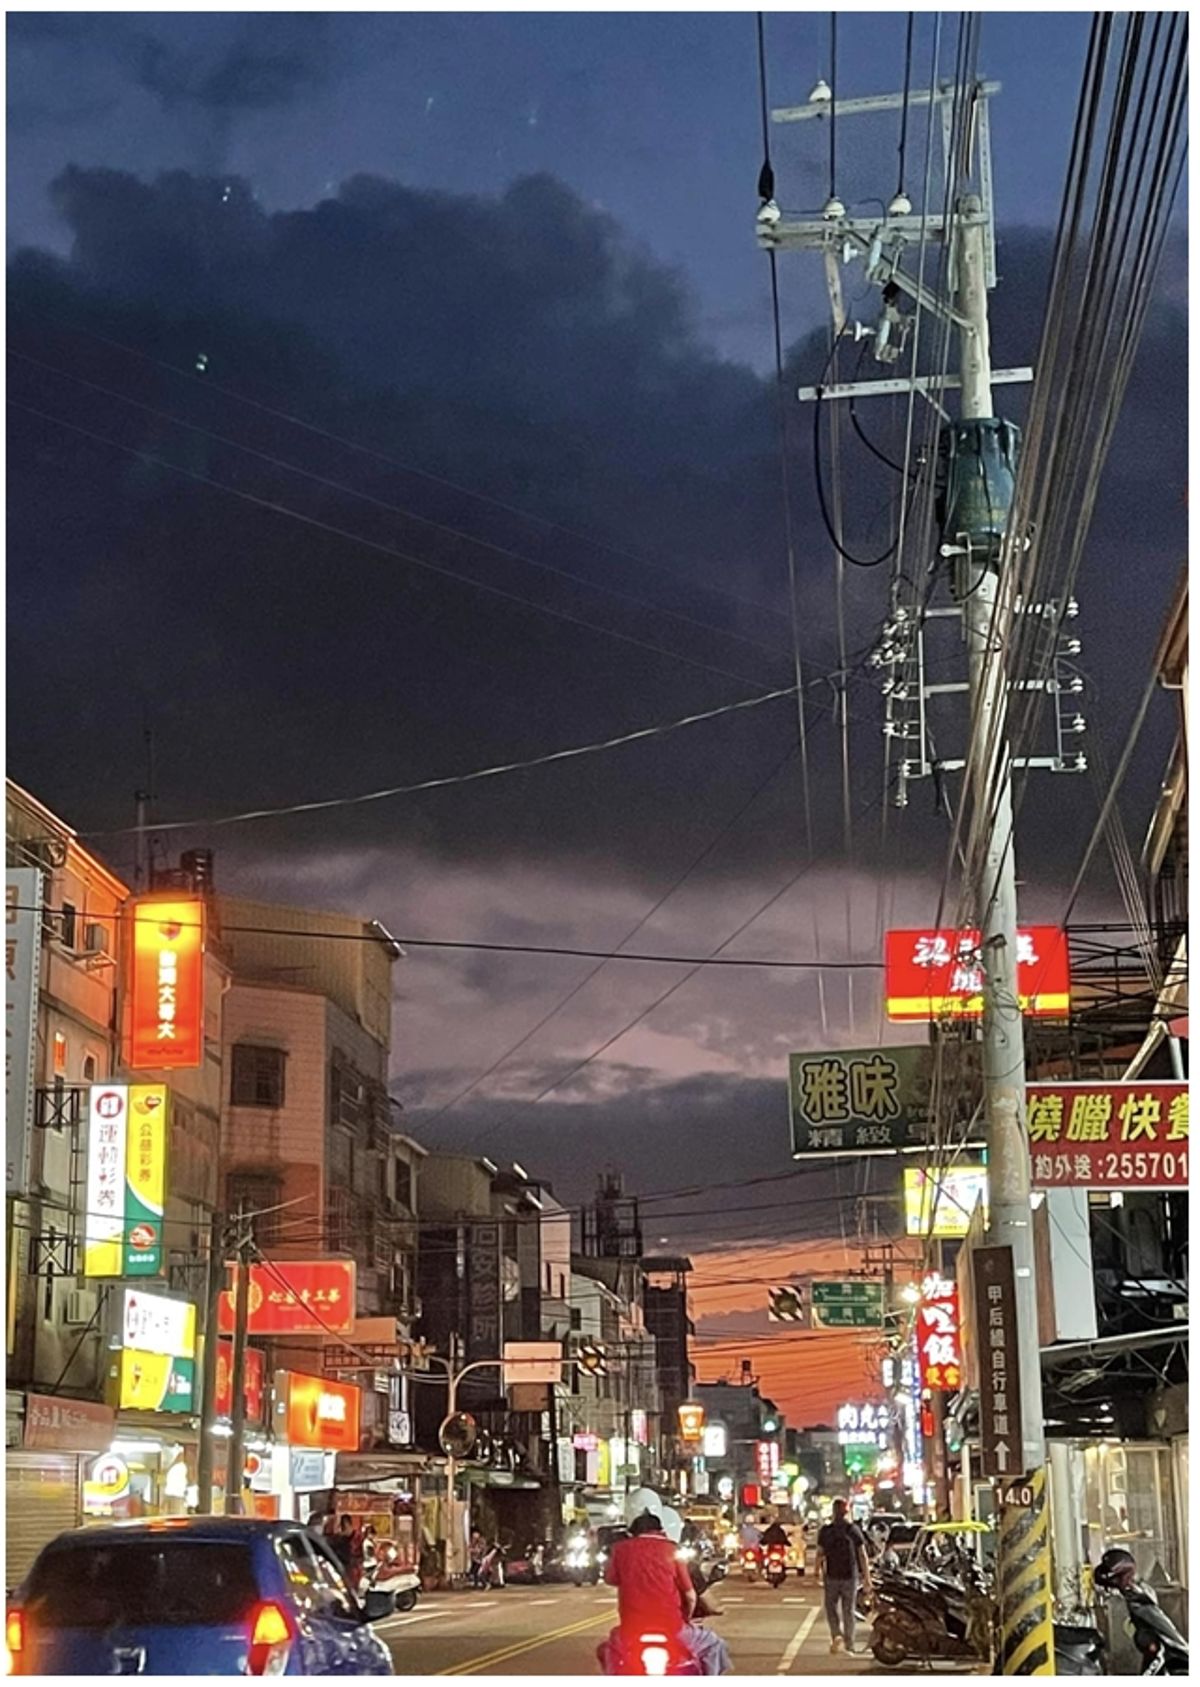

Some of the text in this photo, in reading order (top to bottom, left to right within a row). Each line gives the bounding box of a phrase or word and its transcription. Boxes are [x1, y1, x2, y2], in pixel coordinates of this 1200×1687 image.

[803, 1056, 898, 1124] 雅味
[988, 1285, 1009, 1435] 甲后線自行車道
[996, 1488, 1031, 1505] 14.0
